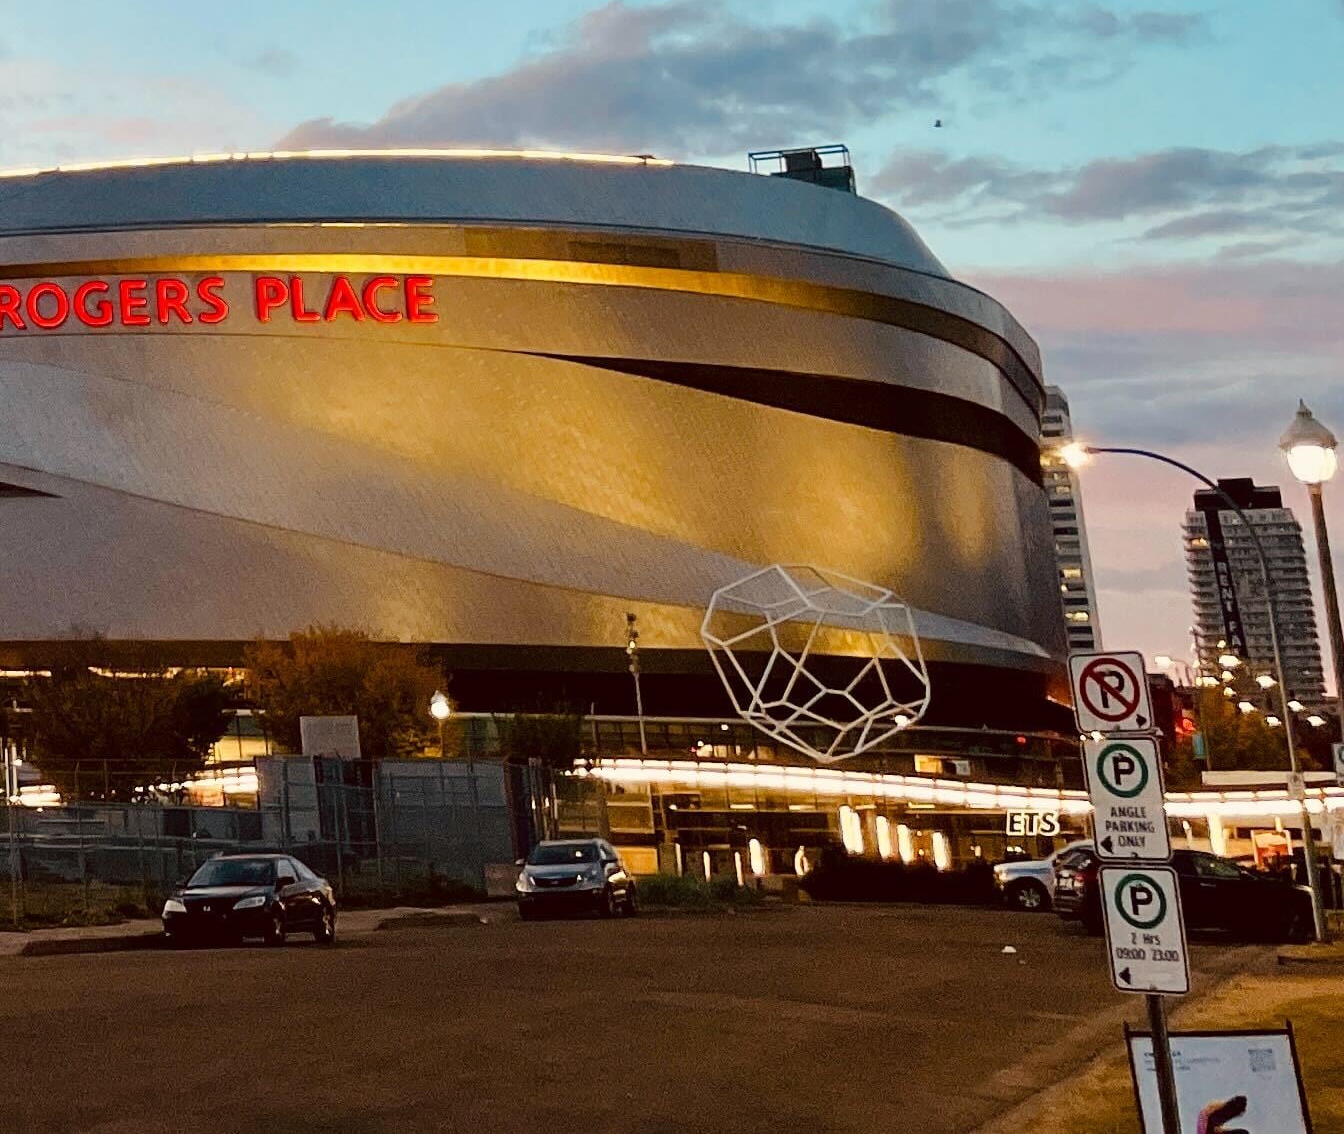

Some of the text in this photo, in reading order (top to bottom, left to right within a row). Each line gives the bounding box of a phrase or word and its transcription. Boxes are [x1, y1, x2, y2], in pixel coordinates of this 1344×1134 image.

[255, 276, 439, 323] PLACE
[1112, 755, 1136, 786] P
[1111, 806, 1147, 818] ANGLE
[1006, 810, 1060, 836] ETS
[1105, 820, 1155, 833] PARKING
[1118, 835, 1147, 848] ONLY
[1129, 886, 1154, 916] P
[1143, 933, 1161, 946] Hrs
